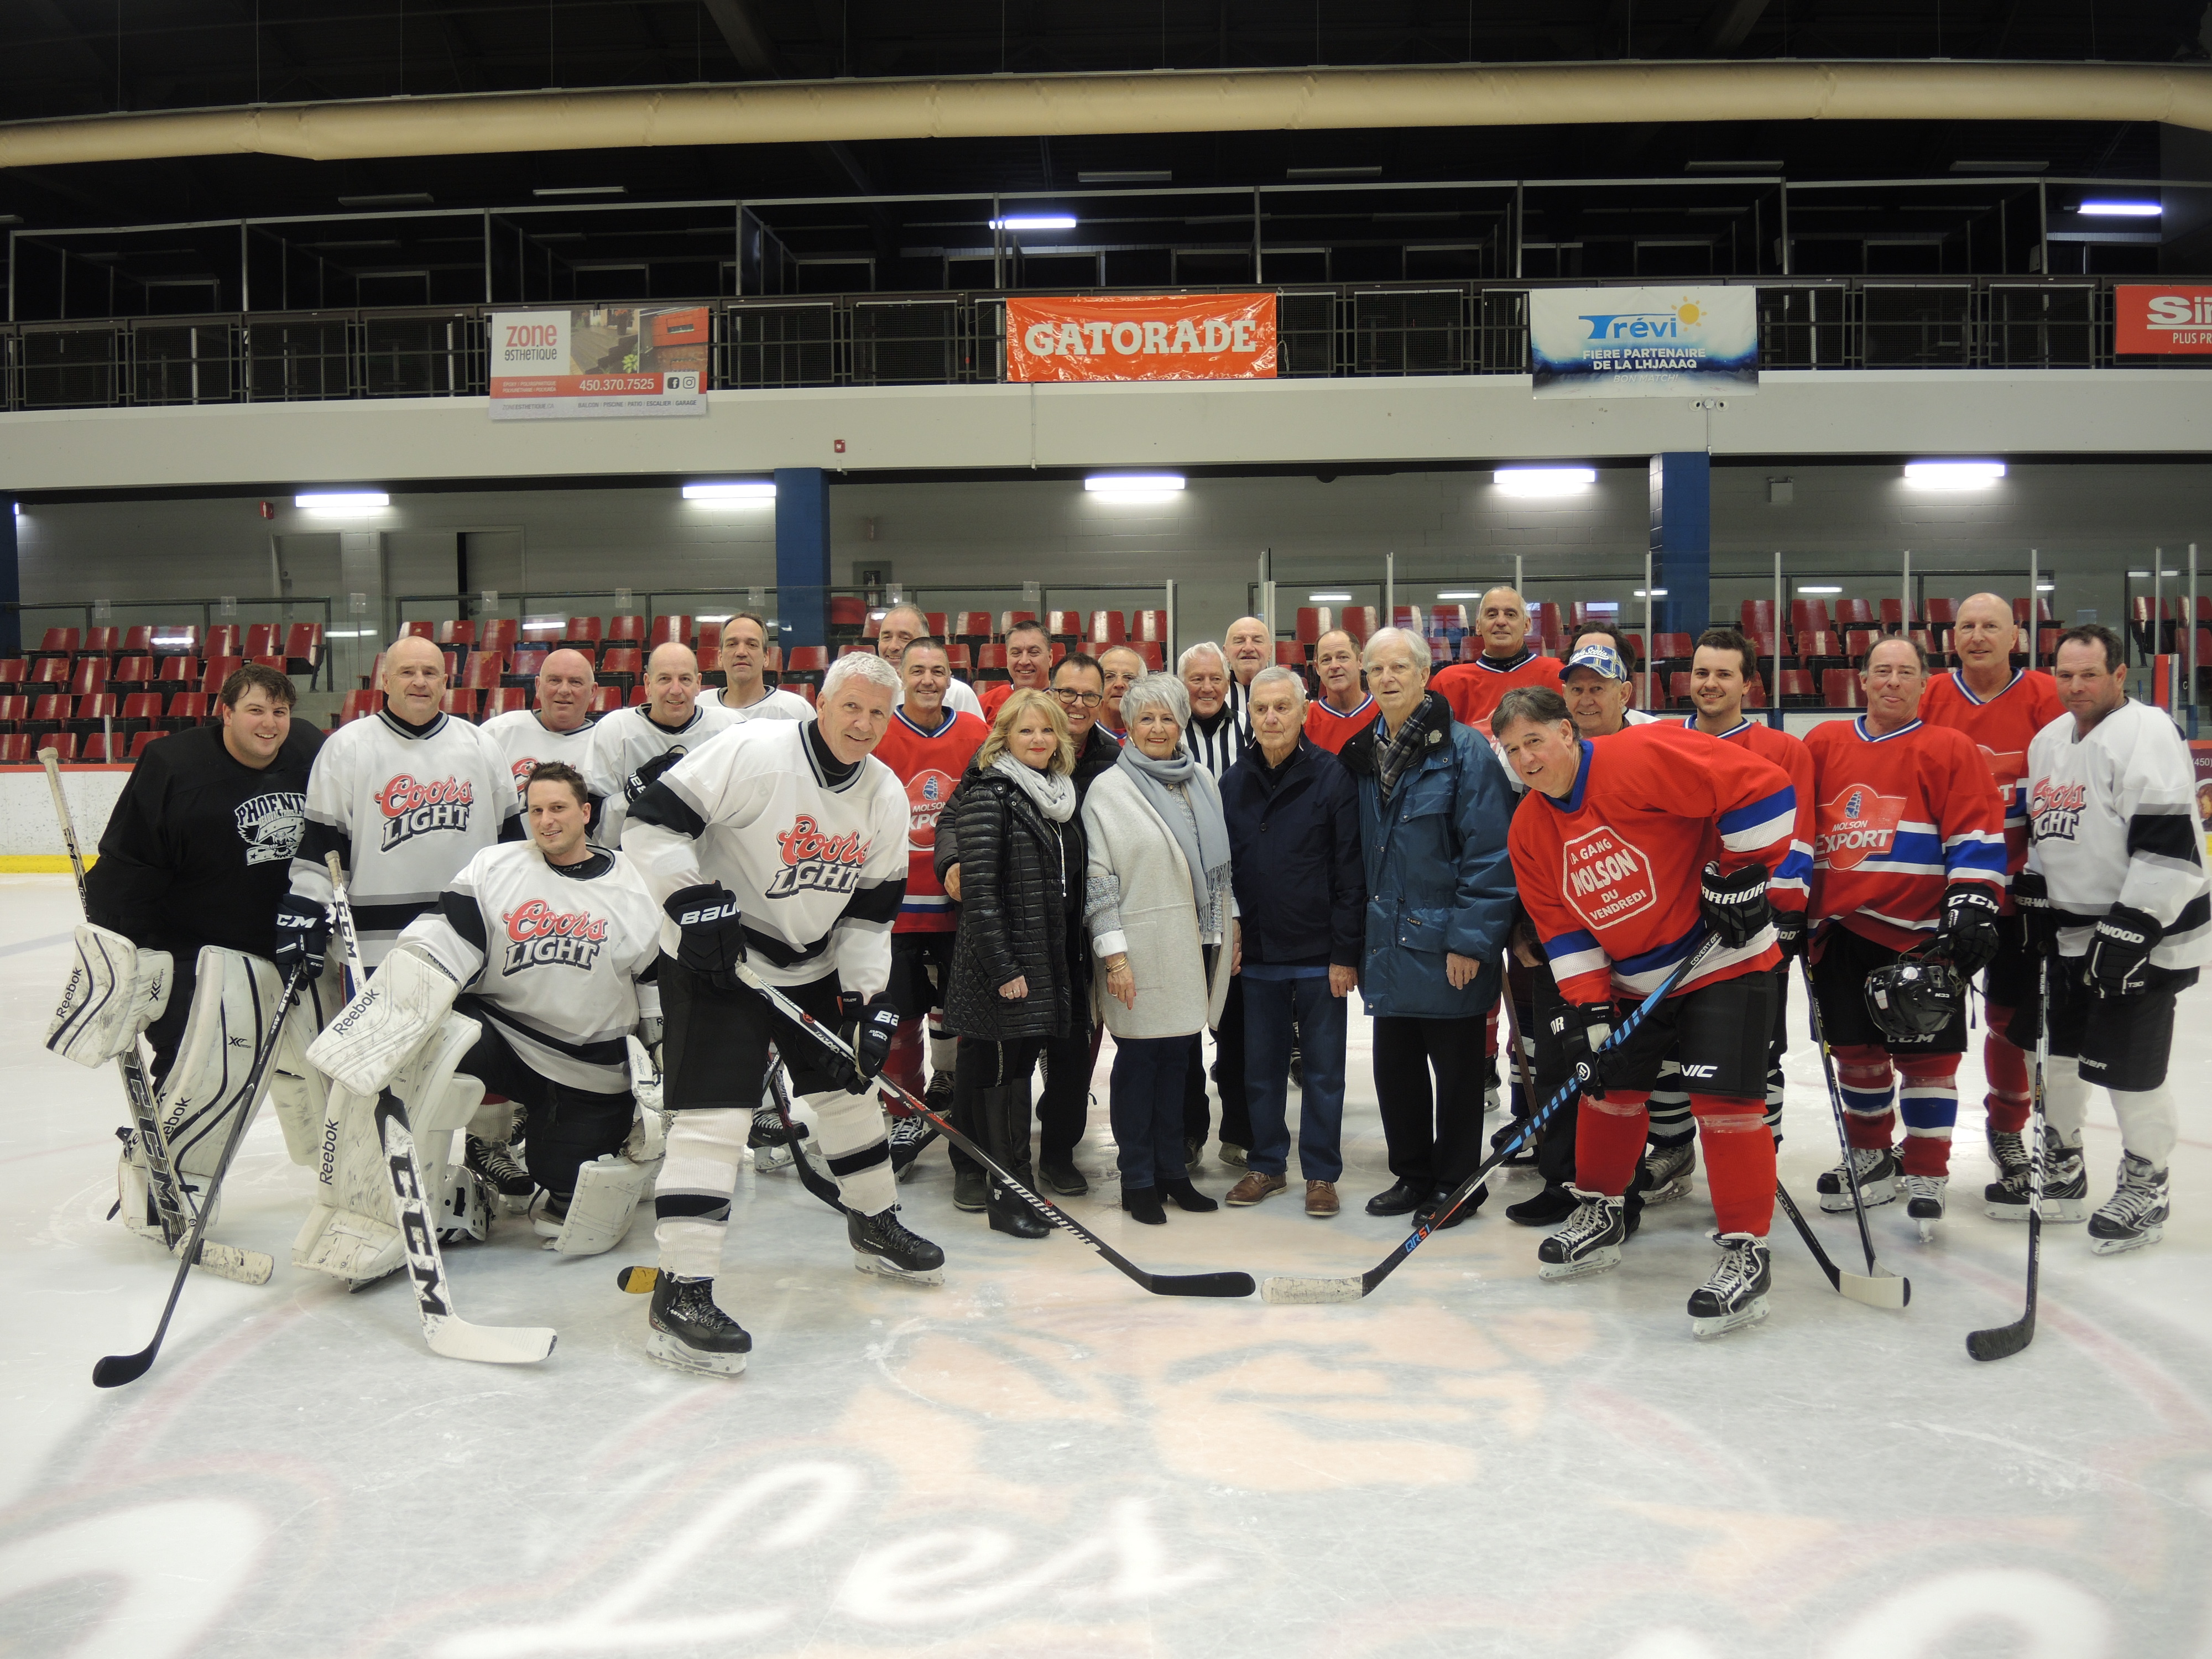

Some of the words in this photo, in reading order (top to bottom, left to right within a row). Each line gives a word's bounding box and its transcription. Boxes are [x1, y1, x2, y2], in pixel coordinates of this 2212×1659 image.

[506, 325, 557, 347] zone
[1025, 320, 1256, 356] GATORADE
[1578, 312, 1677, 340] Trévi
[2173, 332, 2197, 343] PLUS
[1593, 361, 1611, 370] DE
[1615, 360, 1632, 370] LA
[1636, 359, 1697, 369] LHJAAAQ
[1624, 348, 1706, 358] PARTENAIRE
[579, 378, 655, 392] 450.370.7525
[1614, 374, 1637, 383] BON
[1640, 373, 1679, 383] MATCH!
[373, 774, 474, 818] Coors
[381, 804, 469, 852] LIGHT
[1832, 820, 1868, 832] MOLSON
[2033, 810, 2079, 841] GHT
[1580, 838, 1612, 860] GANG
[1814, 829, 1893, 855] EXPORT
[1570, 848, 1639, 897] MOLSON
[1589, 889, 1647, 921] VENDREDI
[1600, 889, 1619, 904] DU
[1702, 881, 1765, 905] ARRIOR
[1948, 894, 2000, 914] CCM
[276, 913, 317, 928] CM
[502, 899, 608, 943] Coors
[680, 901, 739, 925] BAU
[2096, 920, 2145, 944] R-WOOD
[502, 935, 599, 977] LIGHT
[1691, 941, 1712, 966] COVERT
[55, 966, 83, 1019] Reebok
[332, 988, 380, 1035] Reebok
[1681, 1065, 1718, 1078] VIC
[2078, 1053, 2107, 1070] AUER
[163, 1096, 192, 1141] ebok
[319, 1118, 340, 1186] Reebok
[389, 1150, 448, 1317] CCM
[434, 1460, 1228, 1659] Les
